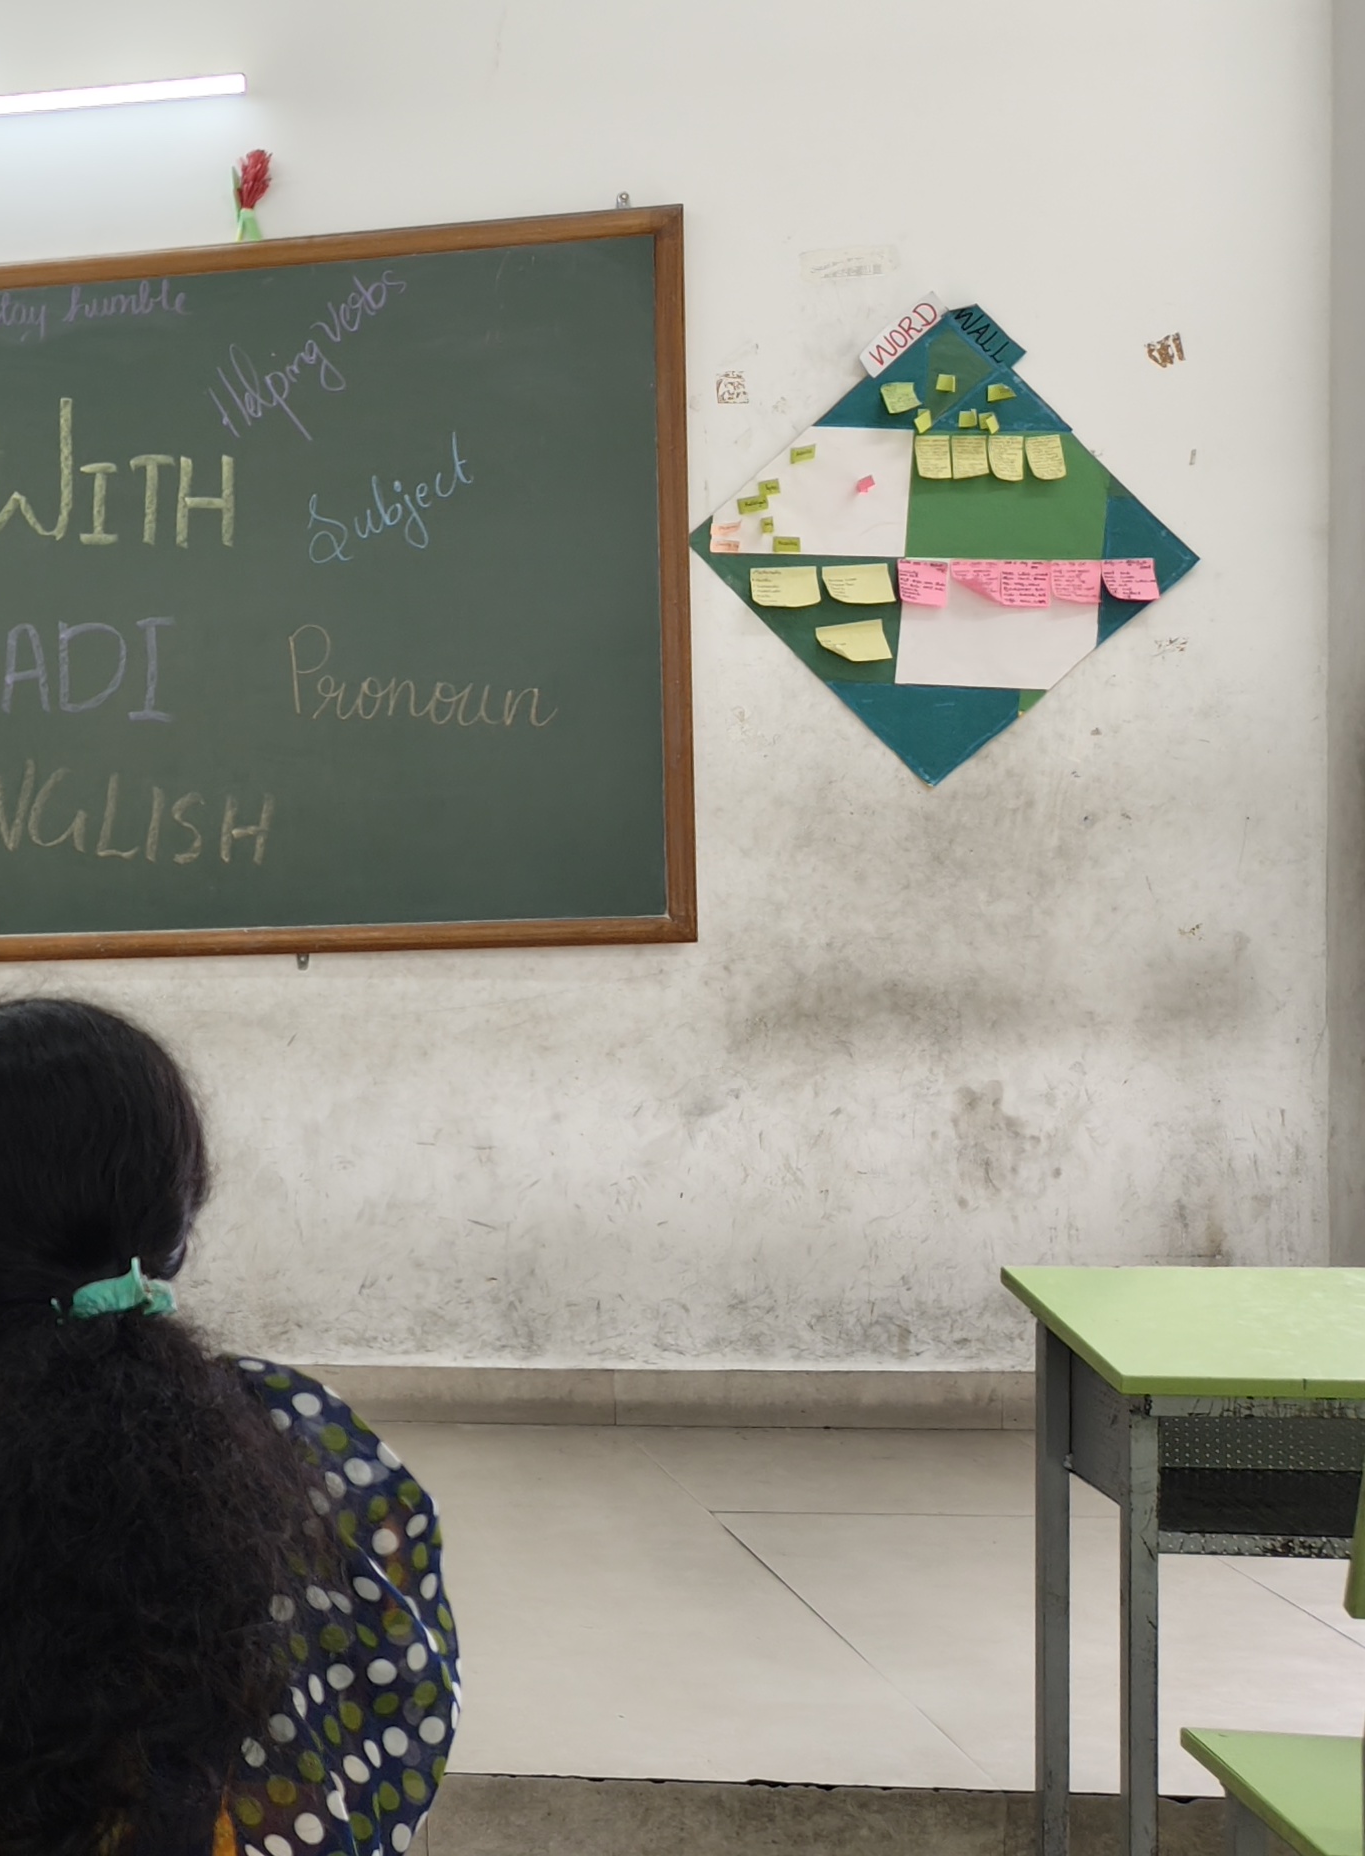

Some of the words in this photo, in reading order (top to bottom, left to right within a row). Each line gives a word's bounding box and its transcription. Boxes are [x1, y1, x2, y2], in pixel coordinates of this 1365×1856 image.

[62, 278, 192, 323] humble
[869, 302, 938, 366] WORD
[954, 308, 1011, 364] WALL
[207, 342, 347, 442] Helping
[308, 431, 474, 564] Subject
[288, 623, 559, 730] Pronoun
